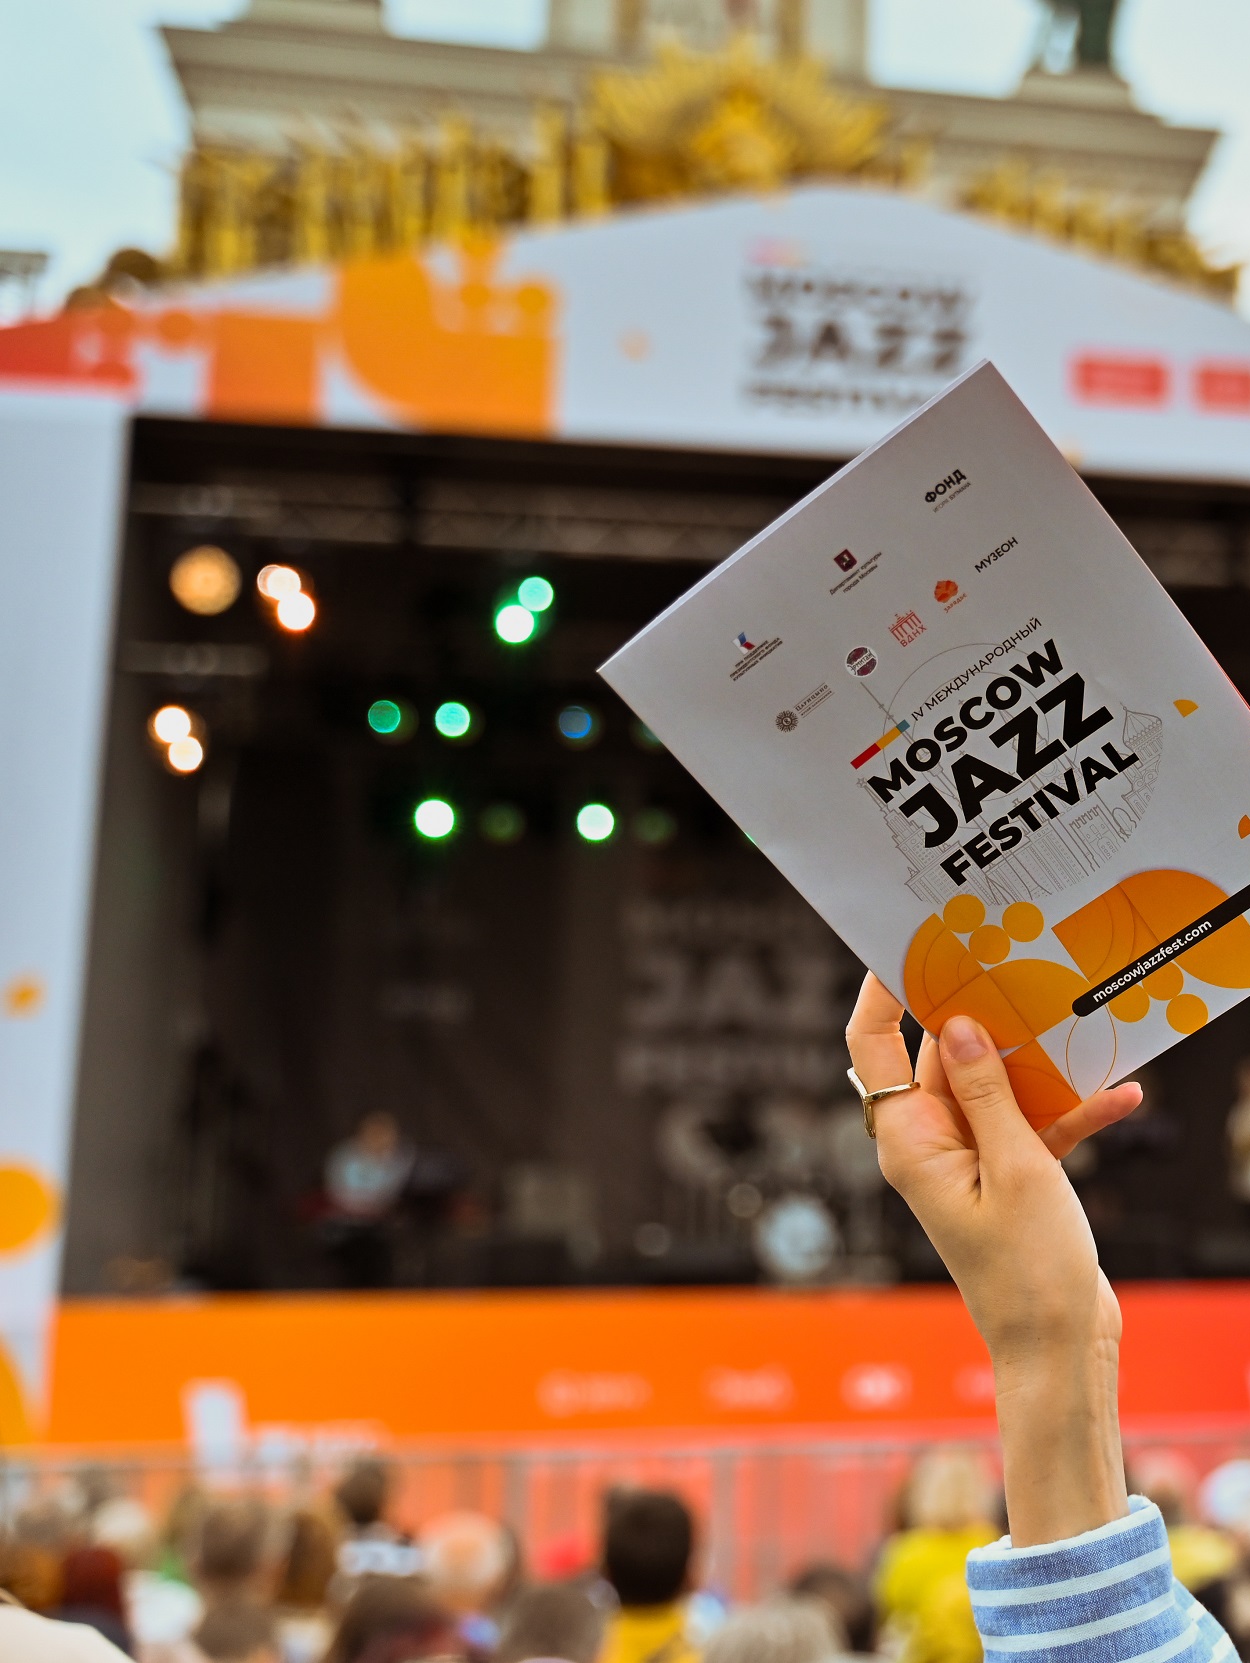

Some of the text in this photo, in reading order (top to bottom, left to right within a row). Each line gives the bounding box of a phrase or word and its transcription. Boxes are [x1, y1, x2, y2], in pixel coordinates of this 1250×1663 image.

[925, 469, 967, 503] ФОНД
[829, 552, 882, 595] Департамент культуры
[842, 565, 878, 593] города Москвы
[974, 536, 1019, 573] МУЗЕОН
[900, 624, 927, 648] ВДНХ
[911, 617, 1042, 721] IV МЕЖДУНАРОДНЫЙ
[867, 638, 1064, 804] MOSCOW
[898, 672, 1114, 849] JAZZ
[940, 742, 1139, 886] FESTIVAL
[1092, 920, 1213, 1003] moscowjazzfest.com
